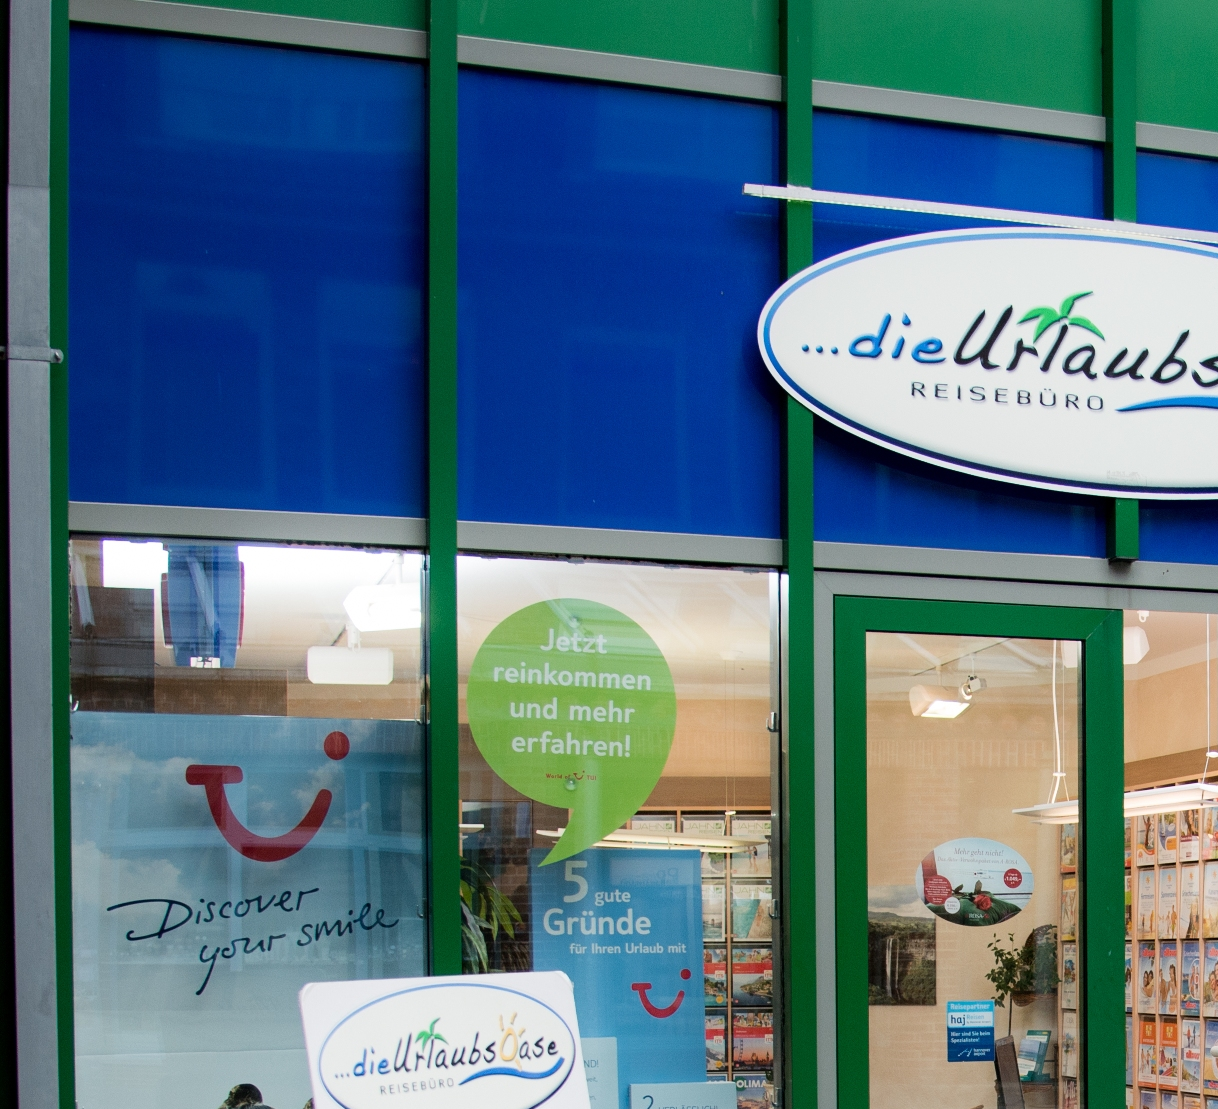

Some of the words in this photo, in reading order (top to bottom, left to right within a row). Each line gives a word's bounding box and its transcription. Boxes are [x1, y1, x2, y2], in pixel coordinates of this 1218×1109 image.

[911, 381, 1105, 411] REISEBÜRO
[540, 628, 608, 654] Jetzt
[493, 662, 652, 691] reinkommen
[510, 700, 557, 720] und
[569, 702, 635, 723] mehr
[511, 732, 631, 757] erfahren!
[562, 861, 588, 903] 5
[594, 889, 631, 907] gute
[107, 887, 319, 941] Discover
[543, 907, 651, 935] Gründe
[195, 933, 287, 995] your
[297, 903, 399, 947] smile
[569, 942, 587, 954] für
[591, 942, 621, 954] Ihren
[625, 942, 664, 954] Urlaub
[667, 943, 687, 954] mit
[950, 1014, 966, 1026] haj
[380, 1077, 455, 1096] REISEBÜRO
